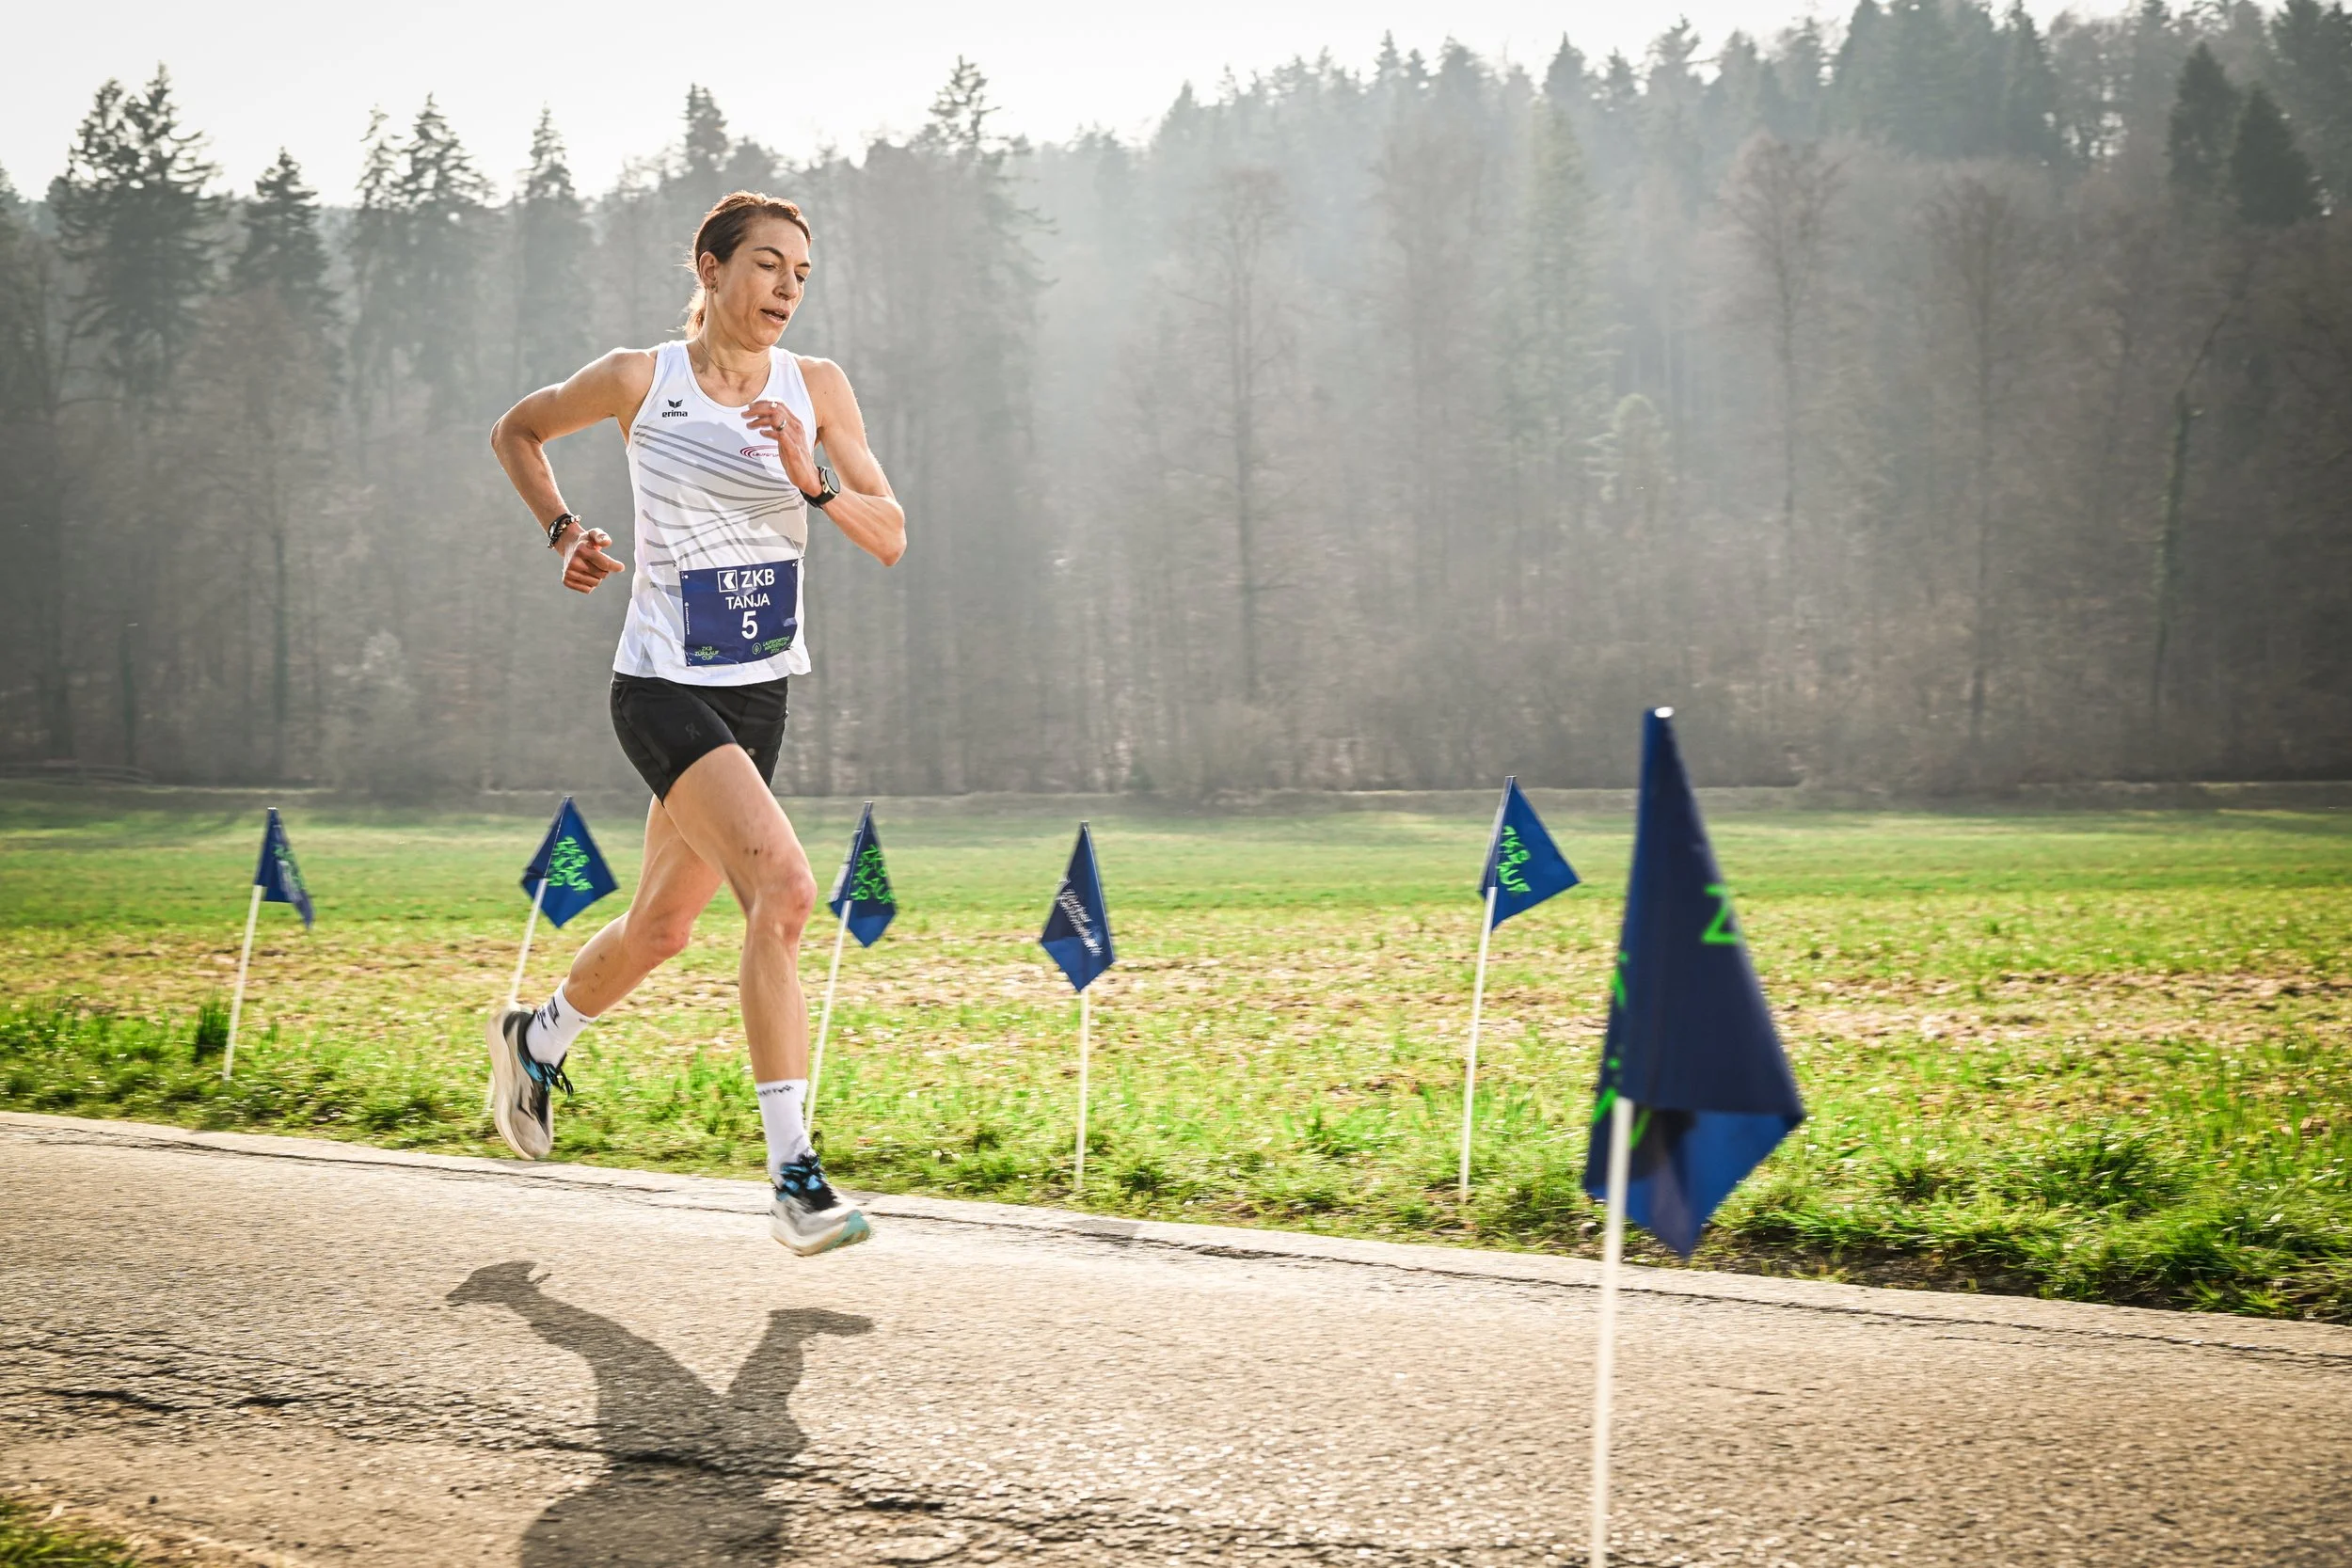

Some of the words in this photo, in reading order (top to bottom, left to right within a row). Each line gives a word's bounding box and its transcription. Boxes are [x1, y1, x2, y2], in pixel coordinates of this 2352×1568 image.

[740, 569, 775, 589] ZKB
[725, 594, 771, 610] TANJA
[741, 610, 758, 640] 5
